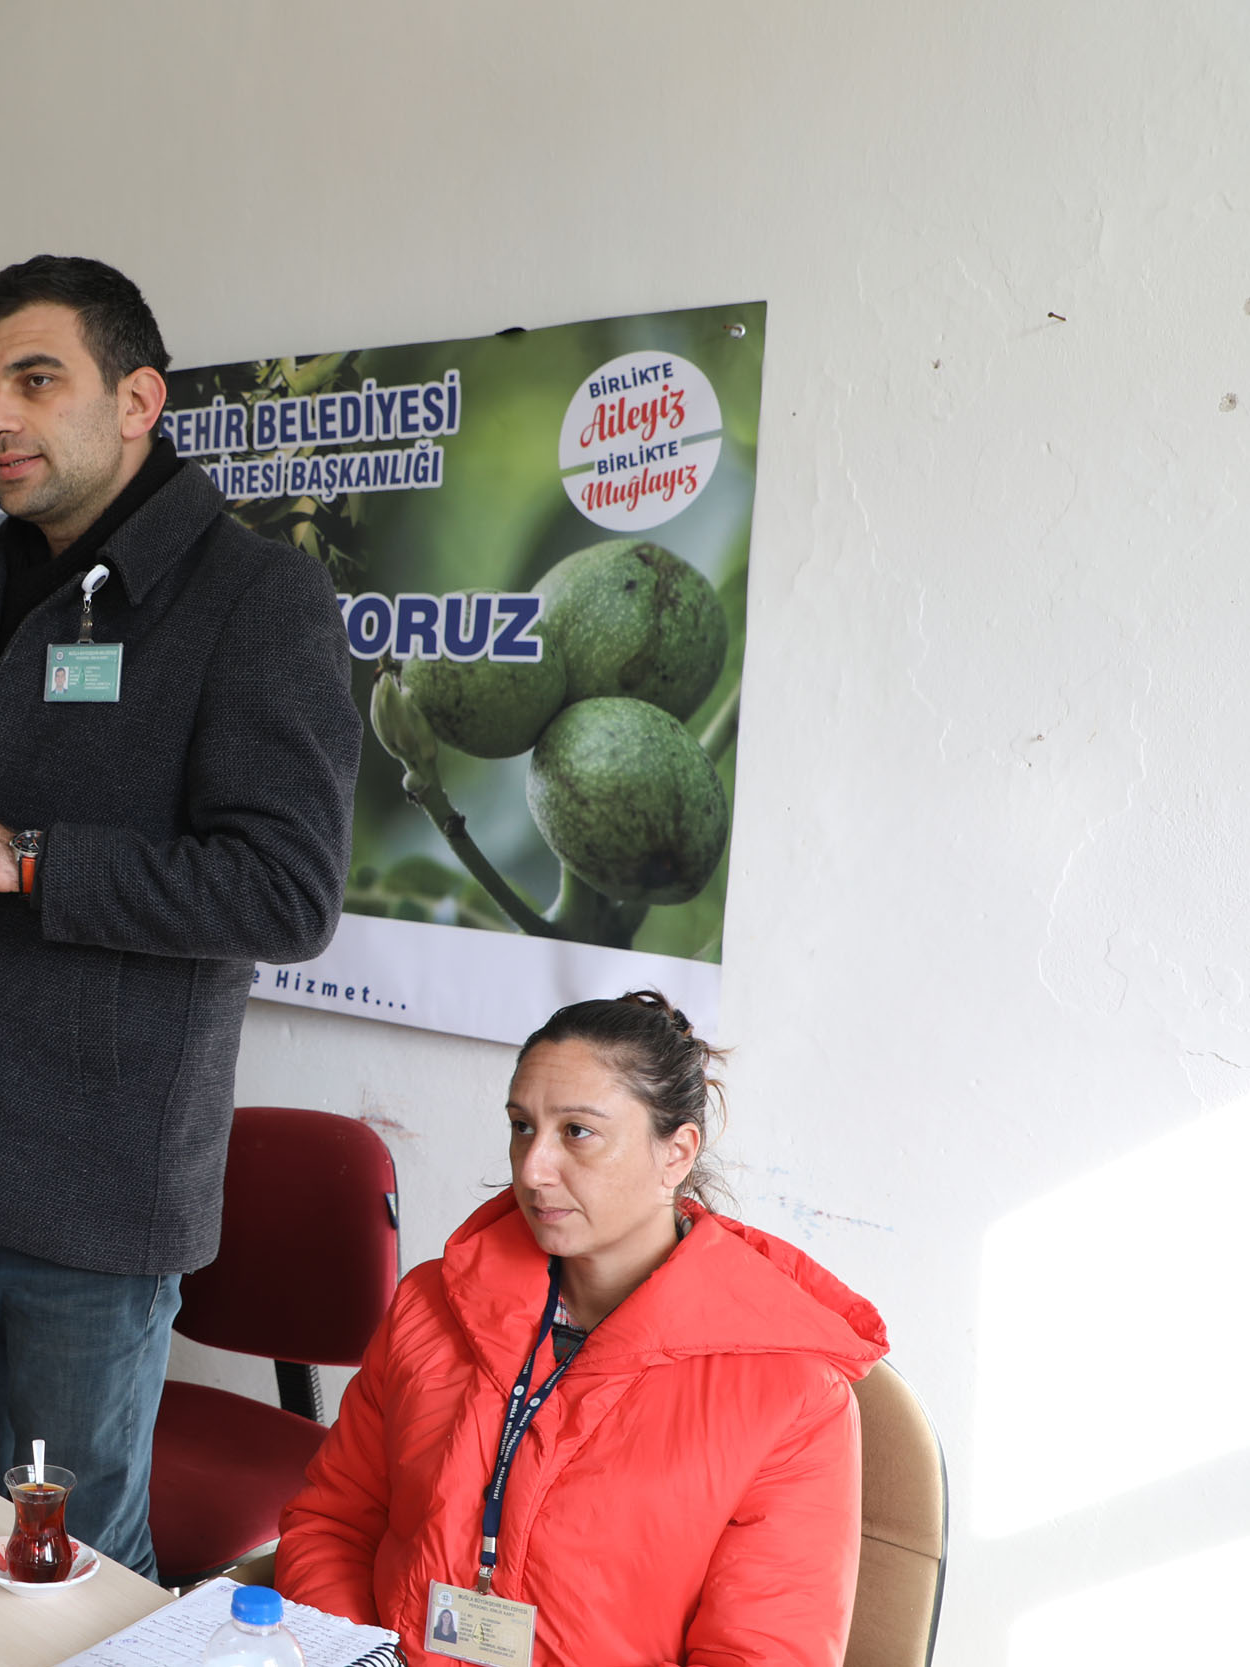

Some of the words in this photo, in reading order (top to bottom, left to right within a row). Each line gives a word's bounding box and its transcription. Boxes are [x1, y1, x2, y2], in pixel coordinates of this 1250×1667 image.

[588, 361, 674, 399] BİRLİKTE
[256, 373, 458, 446] BELEDİYESİ
[579, 383, 686, 448] Aileyiz
[209, 455, 283, 496] AİRESİ
[290, 443, 440, 498] BAŞKANLIĞI
[597, 440, 679, 476] BİRLİKTE
[581, 464, 697, 512] Muğlayız
[337, 597, 540, 657] ORUZ
[275, 969, 407, 1011] Hizmet...
